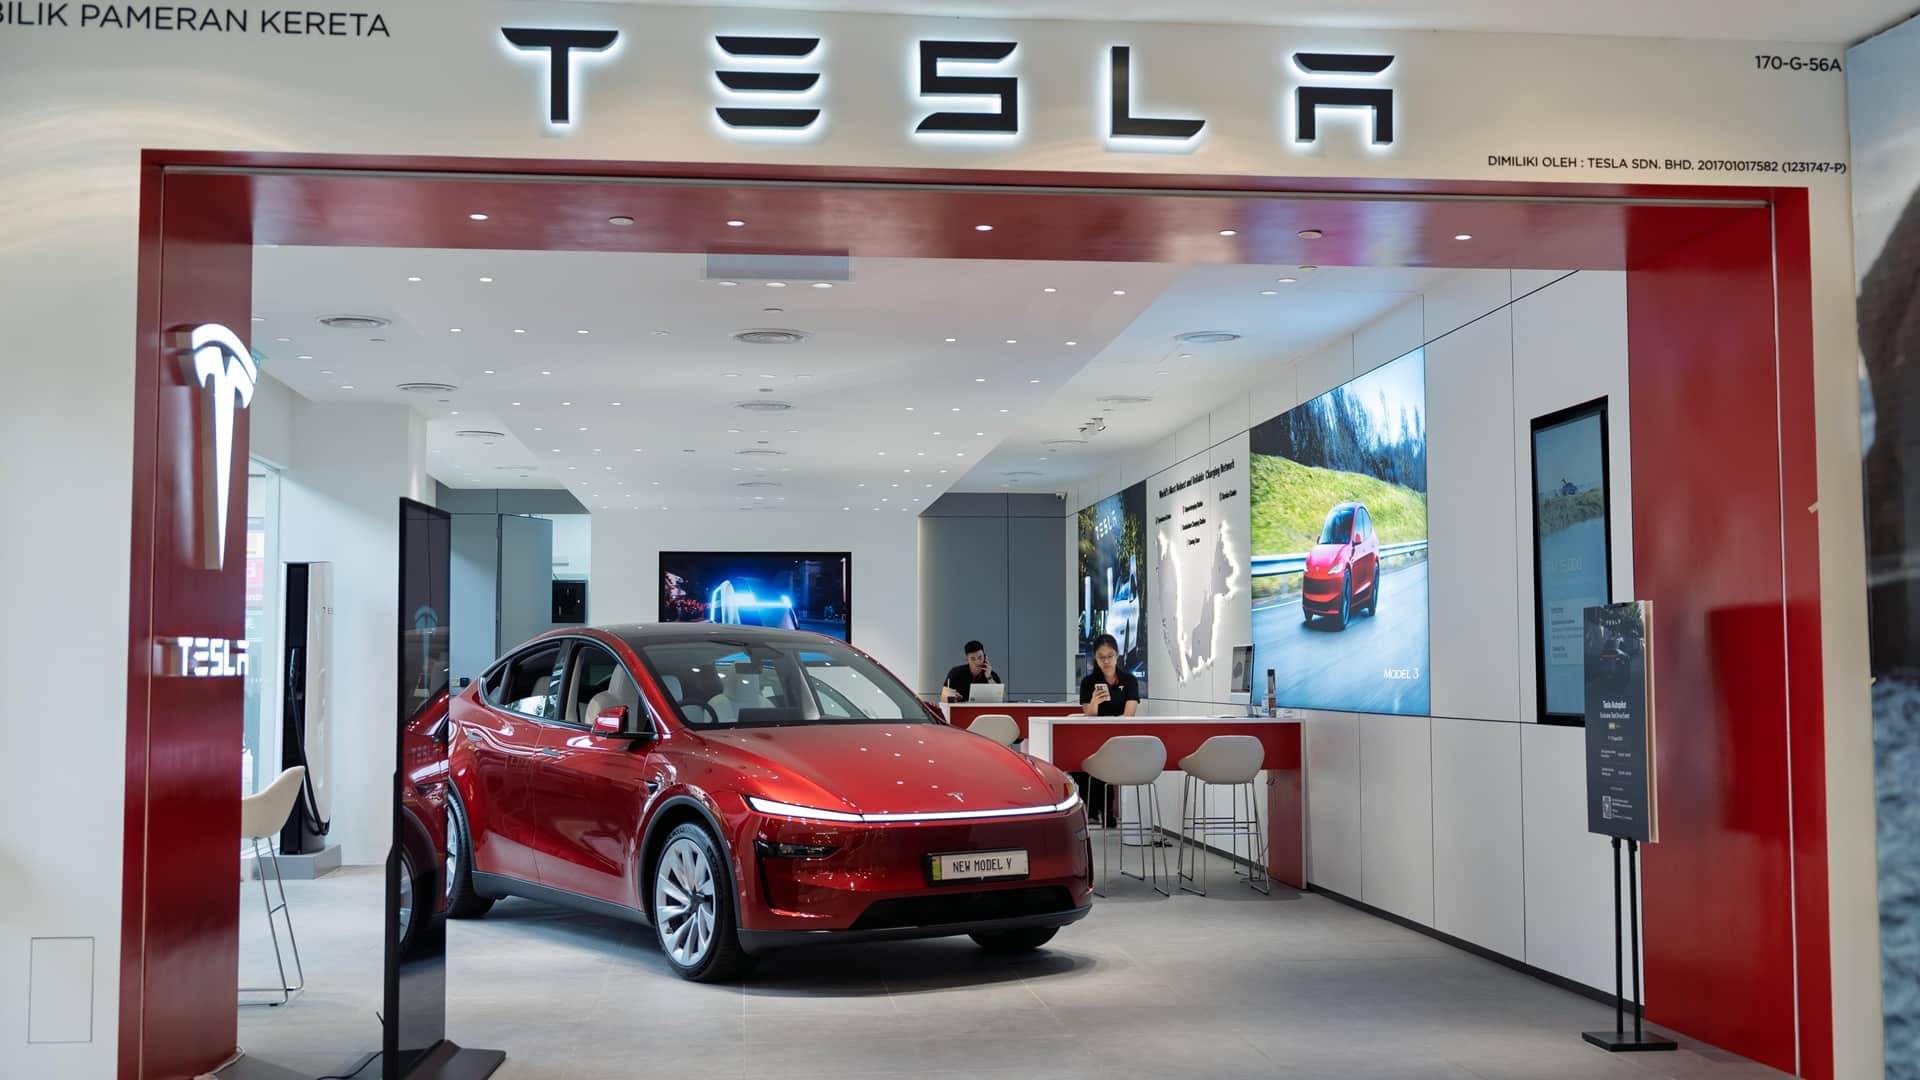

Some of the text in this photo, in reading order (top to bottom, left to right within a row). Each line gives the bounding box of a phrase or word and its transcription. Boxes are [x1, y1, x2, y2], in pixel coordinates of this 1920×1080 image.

[81, 4, 248, 33] PAMERAN
[261, 10, 391, 37] KERETA
[1755, 55, 1843, 72] 170-G-56A
[501, 27, 1396, 146] TESLA
[1488, 155, 1538, 167] DIMILIKI
[1542, 156, 1577, 168] OLEH
[1587, 157, 1629, 169] TESLA
[1631, 158, 1662, 170] SDN.
[1664, 159, 1695, 171] BHD.
[1697, 160, 1778, 172] 201701017582
[1782, 161, 1847, 174] (1231747-P)
[177, 636, 250, 677] TESLA
[1384, 667, 1411, 679] MODEL
[953, 857, 1012, 873] NEW MODEL Y
